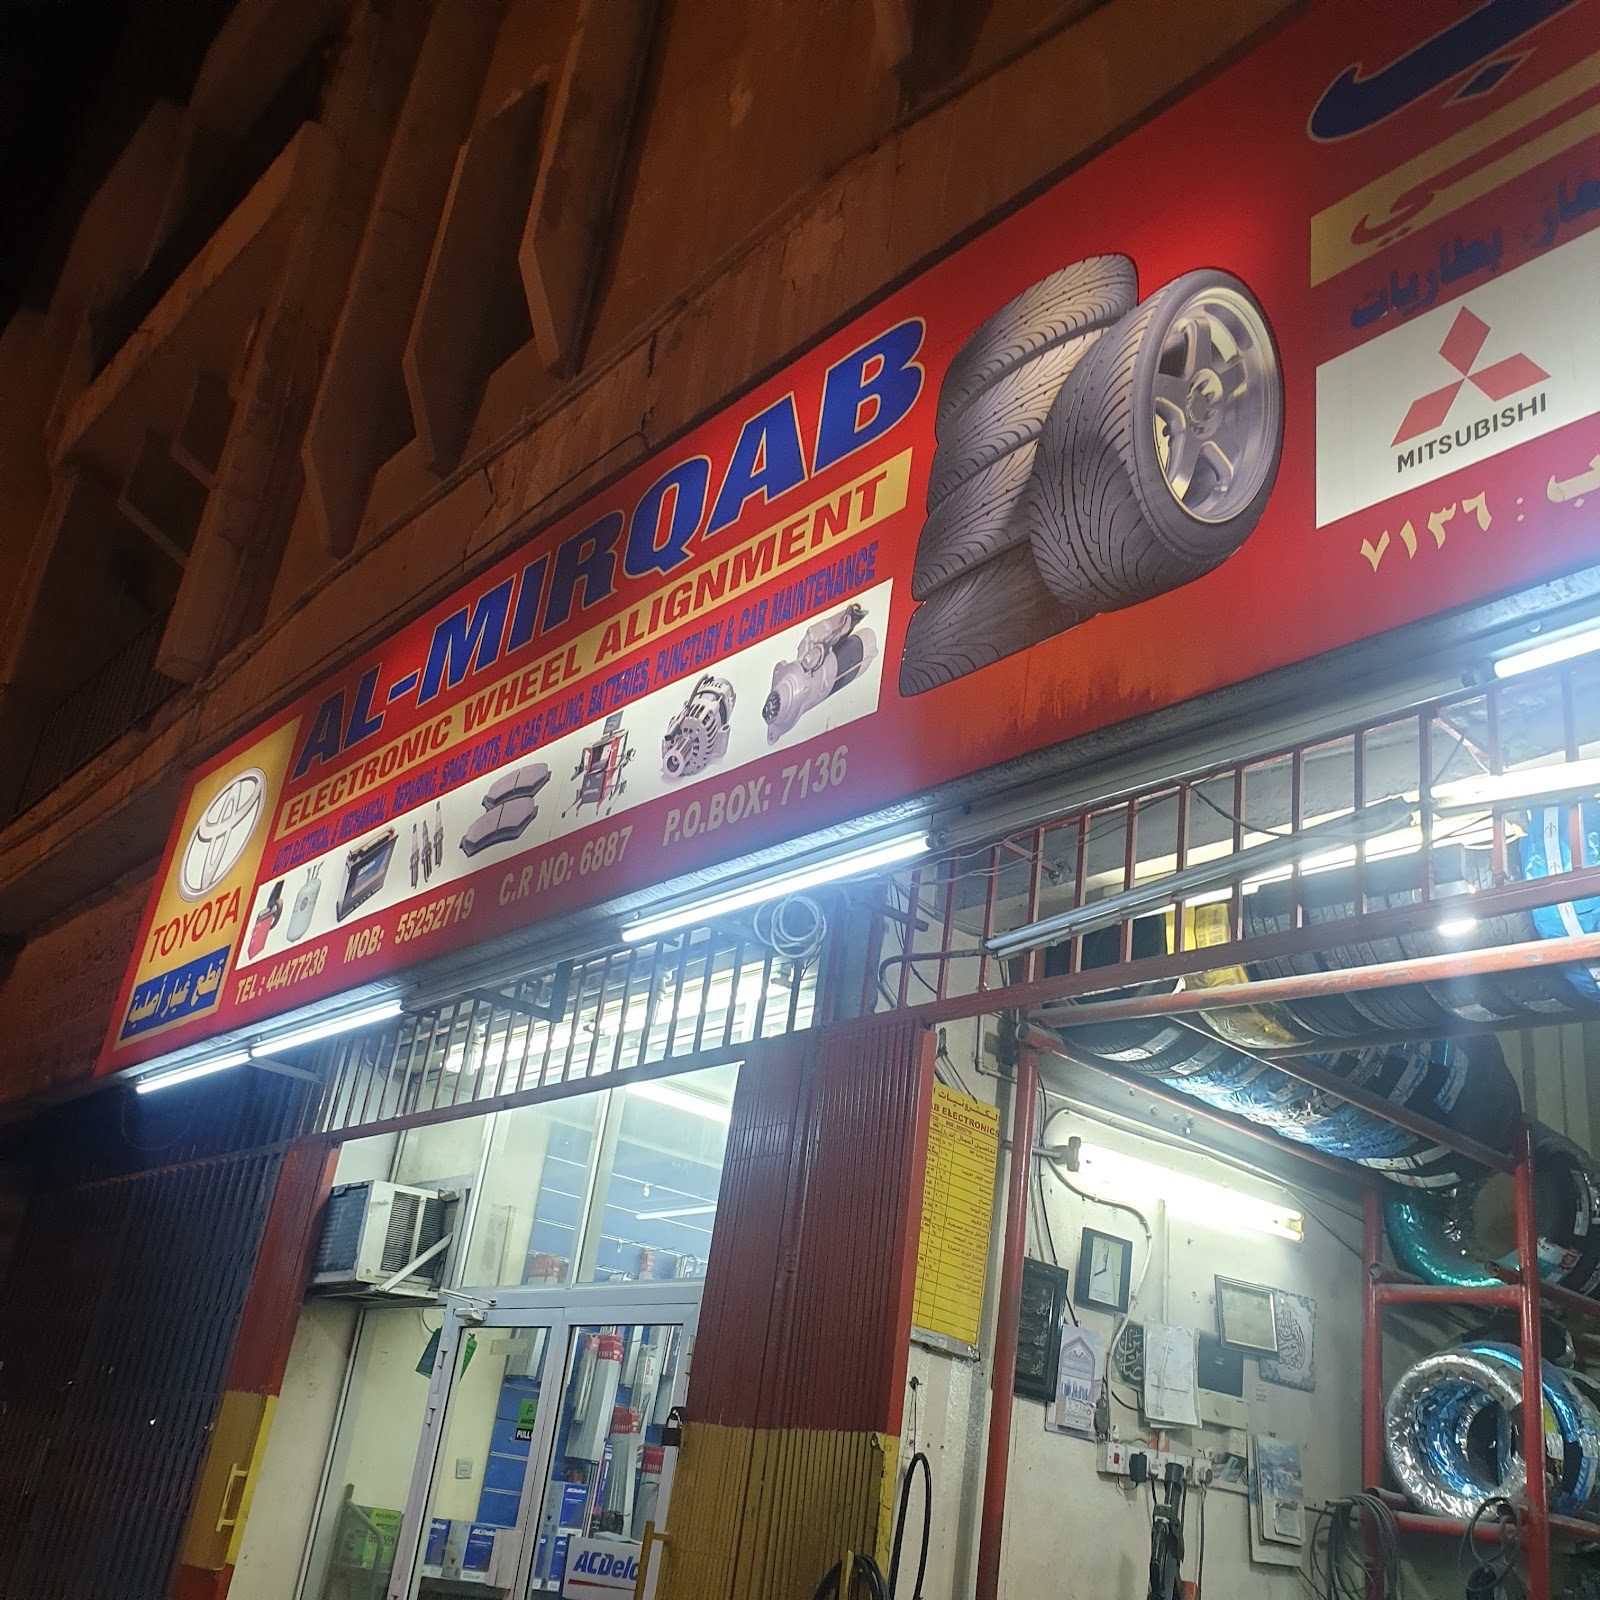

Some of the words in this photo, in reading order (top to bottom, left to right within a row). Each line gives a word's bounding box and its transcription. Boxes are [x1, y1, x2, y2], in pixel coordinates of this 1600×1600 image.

[1397, 393, 1547, 473] MITSUBISHI
[291, 317, 926, 783] AL-MIRQAB
[284, 715, 453, 831] ELECTRONIC
[463, 644, 582, 734] WHEEL
[594, 470, 891, 665] ALIGNMENT
[519, 711, 543, 752] GAS
[654, 619, 725, 685] PUNCTURY
[723, 614, 735, 651] &
[738, 597, 768, 646] CAR
[769, 540, 879, 631] MAINTENANCE
[265, 945, 329, 993] 44477238
[343, 924, 385, 964] MOB:
[394, 887, 476, 945] 55252719
[499, 864, 535, 907] C.R
[536, 851, 575, 893] NO:
[579, 824, 634, 876] 6887
[662, 775, 772, 847] P.O.BOX:
[780, 744, 849, 806] 7136
[149, 886, 242, 964] TOYOTA
[159, 972, 193, 1020] غيار
[190, 957, 226, 1008] قطع
[516, 1430, 531, 1439] PULL
